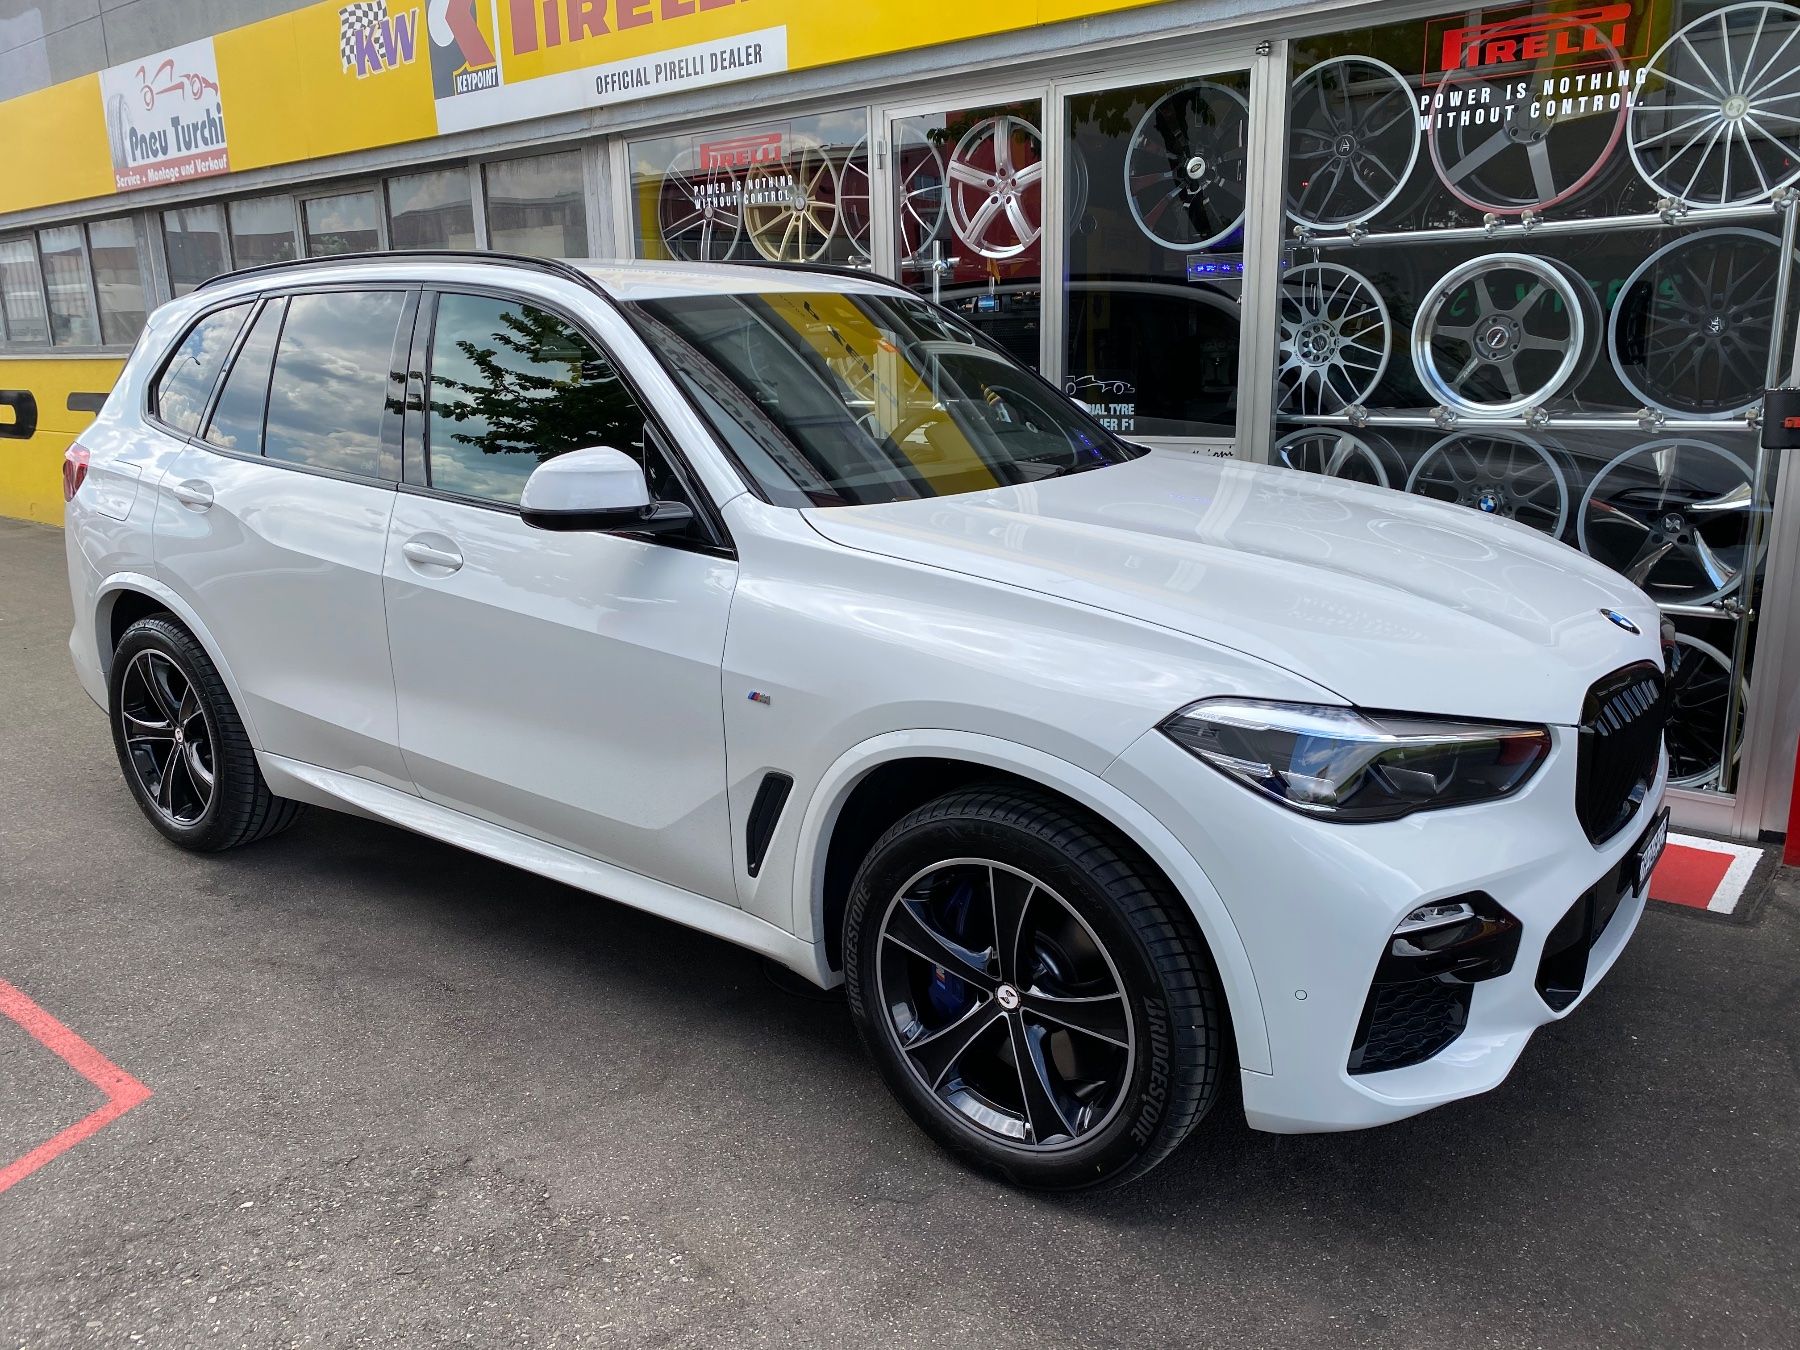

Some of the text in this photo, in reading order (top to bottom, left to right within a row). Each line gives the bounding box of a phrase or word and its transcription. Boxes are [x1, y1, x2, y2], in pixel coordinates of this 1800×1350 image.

[354, 8, 419, 79] KW
[509, 0, 750, 56] IREL
[1441, 3, 1631, 70] PIRELLI
[457, 67, 497, 93] KEYPOINT
[596, 43, 763, 95] OFFICIAL PIRELLI DEALER
[1420, 67, 1647, 111] POWER IS NOTHING
[129, 102, 225, 161] Pneu Turchi
[1420, 91, 1644, 131] WITHOUT CONTROL.
[116, 171, 140, 187] Service
[148, 167, 179, 181] Montage
[181, 160, 194, 176] und
[196, 154, 227, 173] Verkauf
[700, 132, 782, 170] PIRELLI
[694, 175, 793, 197] POWER IS NOTHING
[695, 190, 793, 210] WITHOUT CONTROL.
[1109, 403, 1134, 415] TYRE
[1121, 418, 1134, 431] F1
[846, 882, 871, 1017] BRIDGESTONE
[1131, 996, 1170, 1146] BRIDGESTONE
